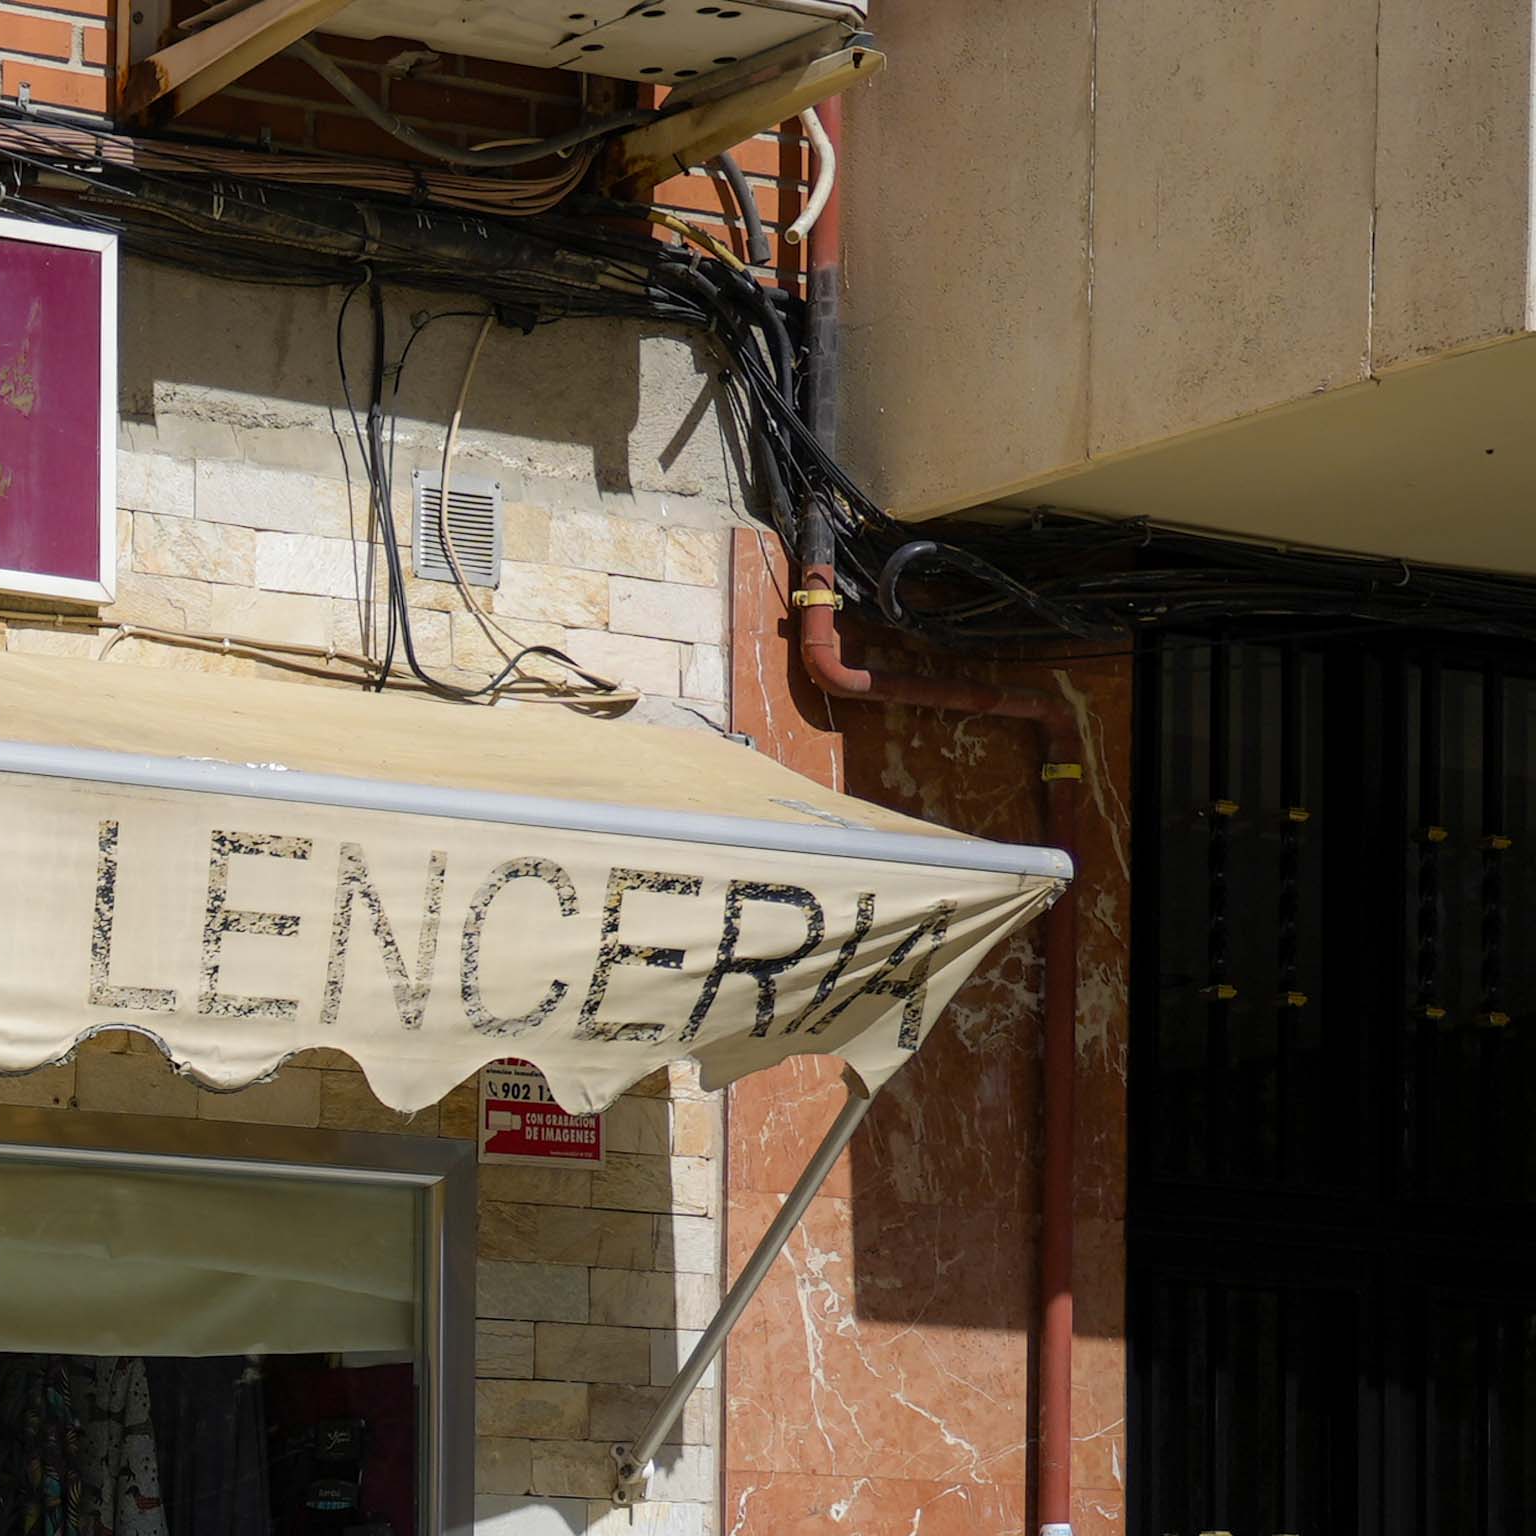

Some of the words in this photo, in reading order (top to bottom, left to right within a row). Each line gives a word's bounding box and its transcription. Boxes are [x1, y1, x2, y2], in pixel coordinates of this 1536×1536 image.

[87, 819, 957, 1051] LENCERIA
[501, 1081, 531, 1100] 902
[525, 1112, 545, 1126] CON
[525, 1126, 539, 1141] DE
[541, 1127, 597, 1145] IMAGENES
